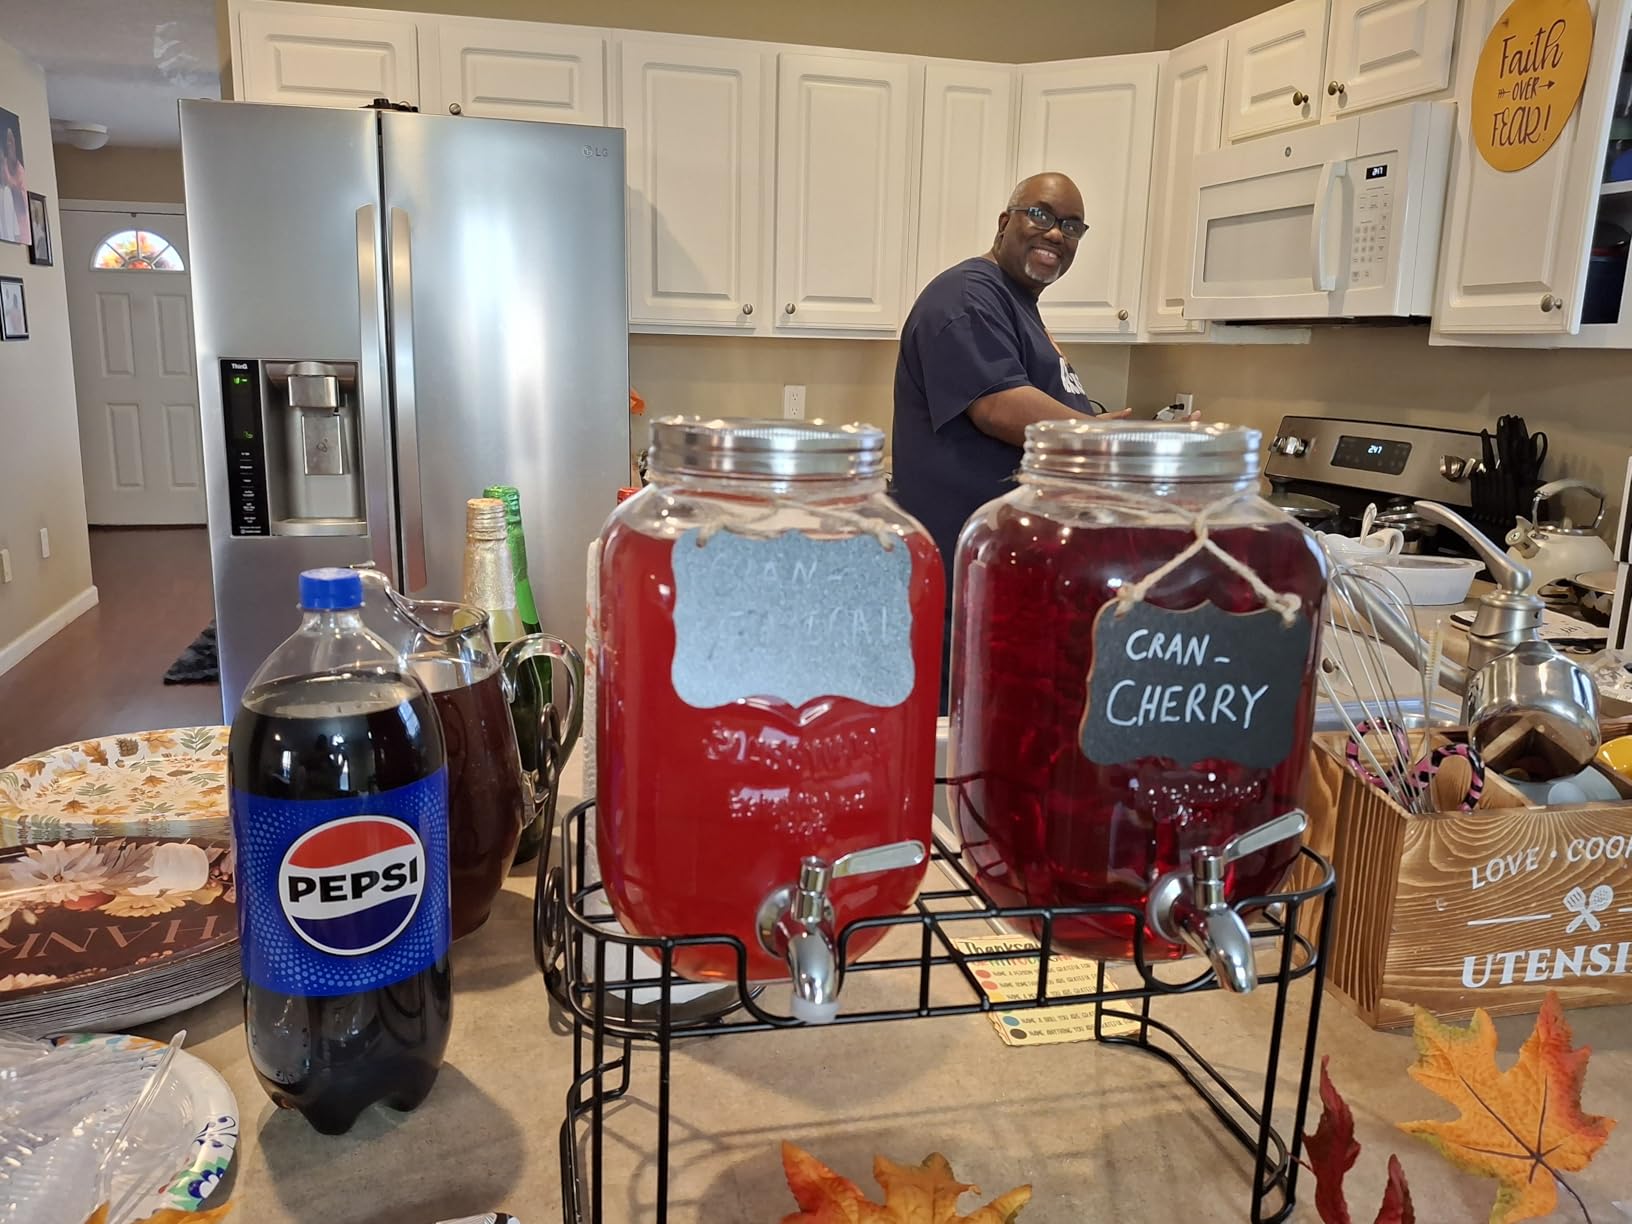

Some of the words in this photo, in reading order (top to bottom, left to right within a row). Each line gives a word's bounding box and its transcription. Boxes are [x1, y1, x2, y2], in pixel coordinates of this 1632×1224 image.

[1500, 18, 1566, 79] Faith
[1511, 76, 1540, 101] OVER
[1491, 104, 1551, 147] FEAR!
[595, 146, 608, 158] LG
[1105, 679, 1269, 729] CHERRY
[288, 856, 418, 903] PEPSI
[1471, 847, 1540, 890] LOVE
